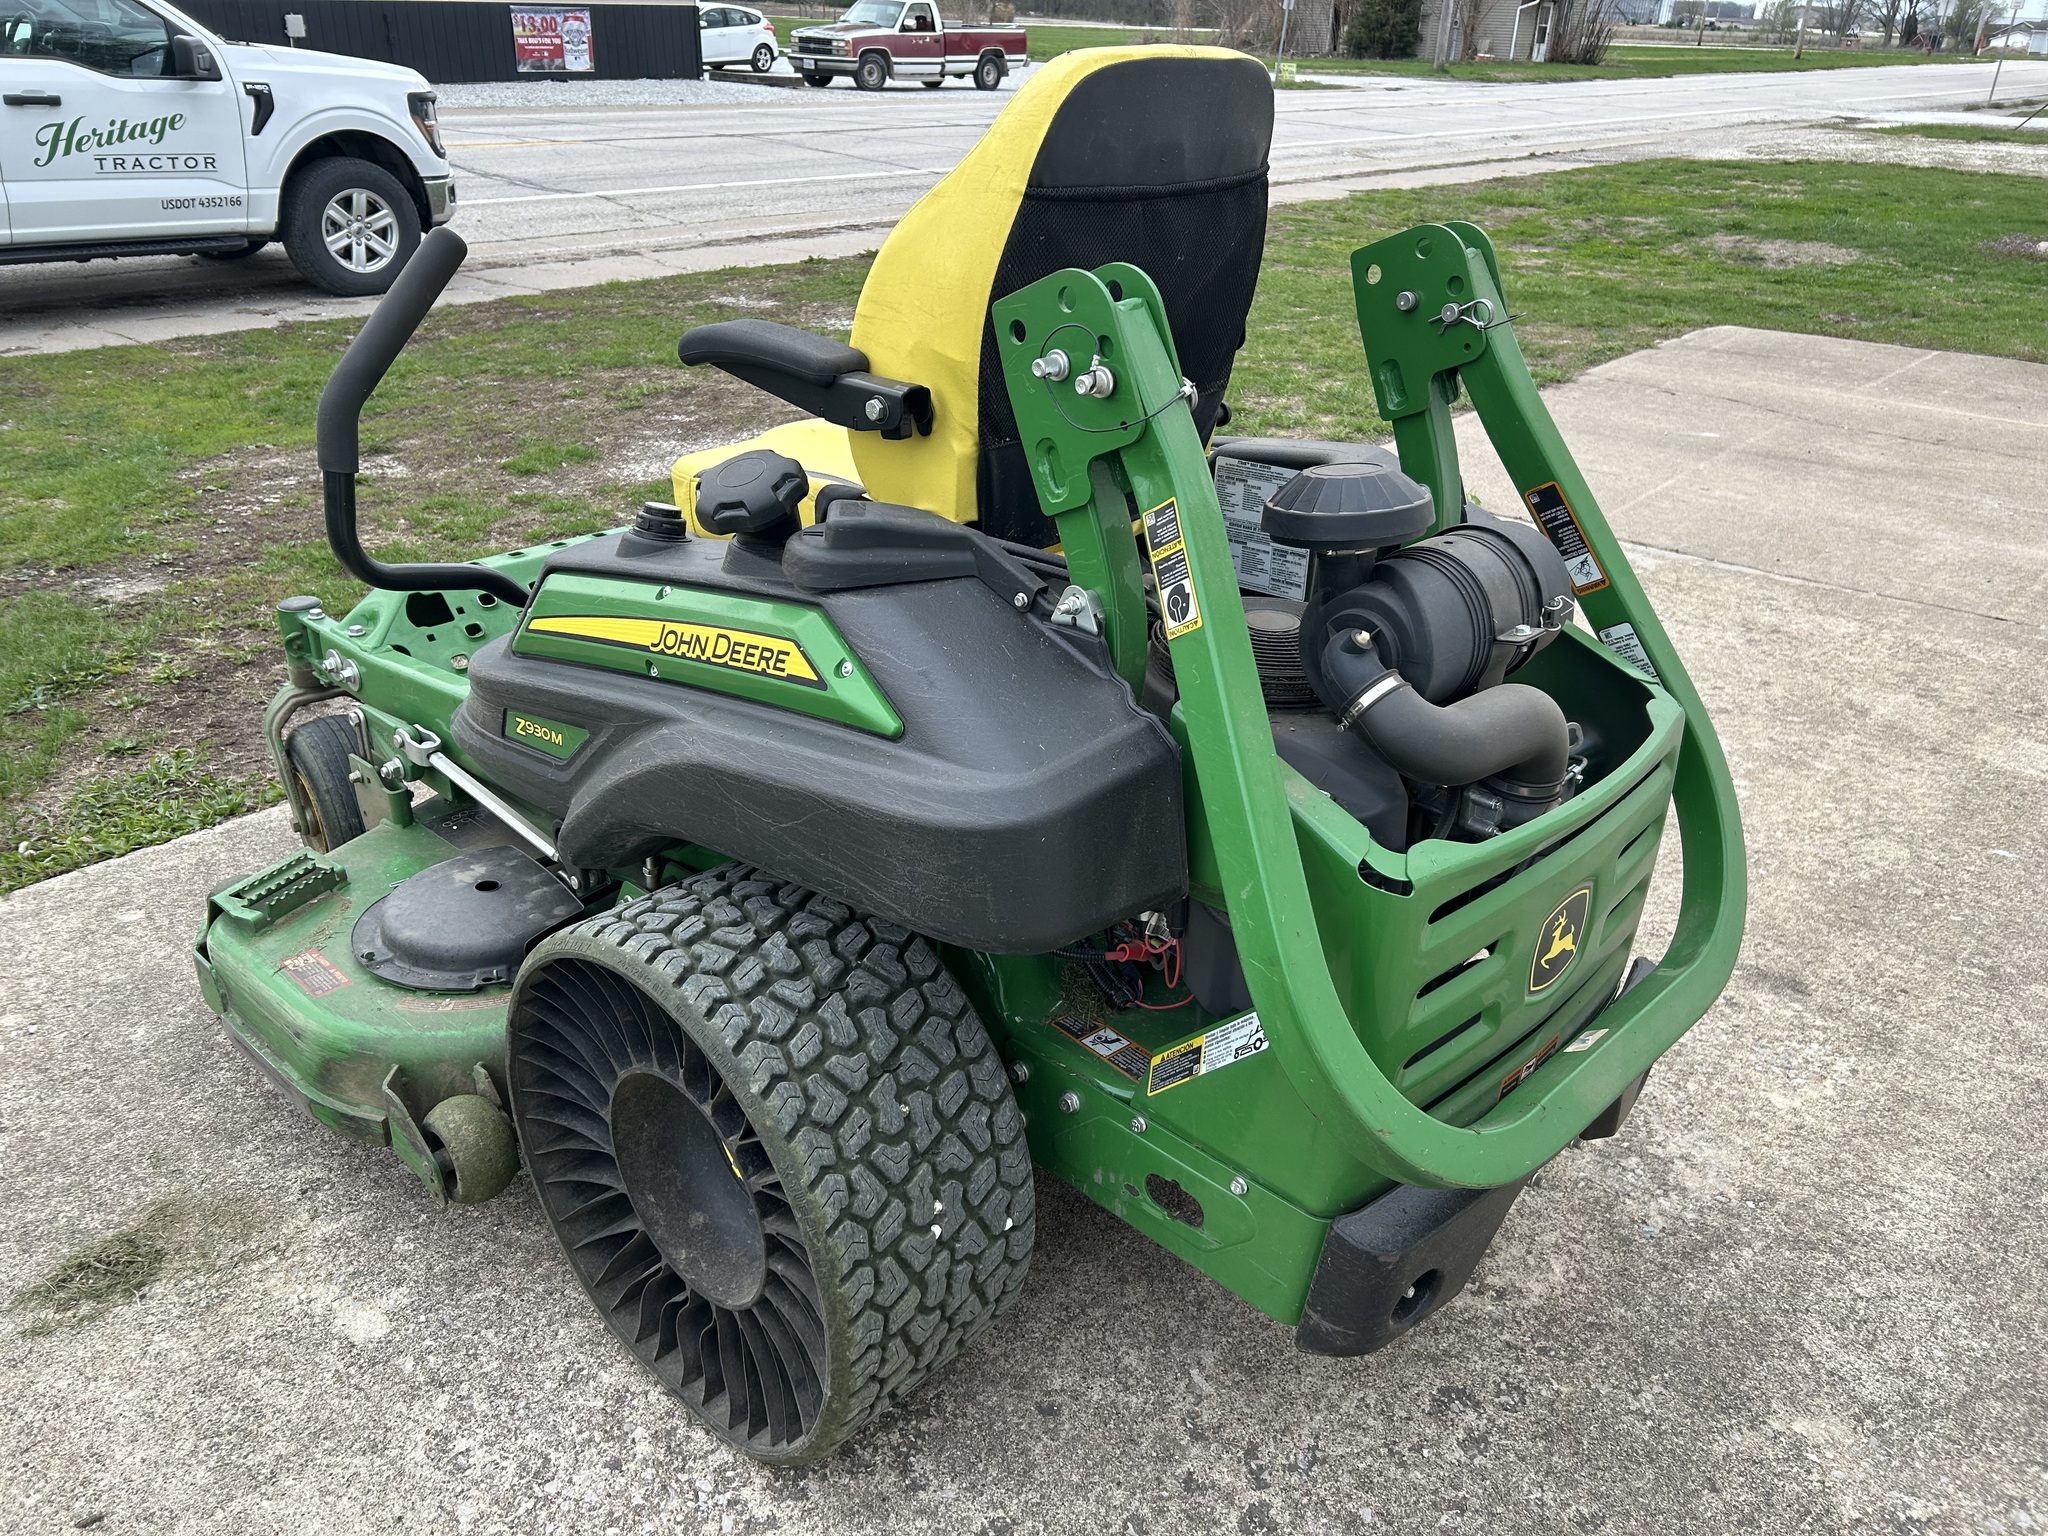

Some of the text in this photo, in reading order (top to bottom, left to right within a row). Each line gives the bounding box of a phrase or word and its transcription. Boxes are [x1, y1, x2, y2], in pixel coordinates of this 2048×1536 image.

[513, 14, 557, 33] $13.00
[33, 112, 187, 168] Heritage
[95, 156, 217, 172] TRACTOR
[161, 196, 242, 210] USDOT 4352166
[650, 624, 791, 674] JOHN DEERE
[515, 717, 563, 746] Z930M
[1165, 1041, 1194, 1060] ATENCIÓN
